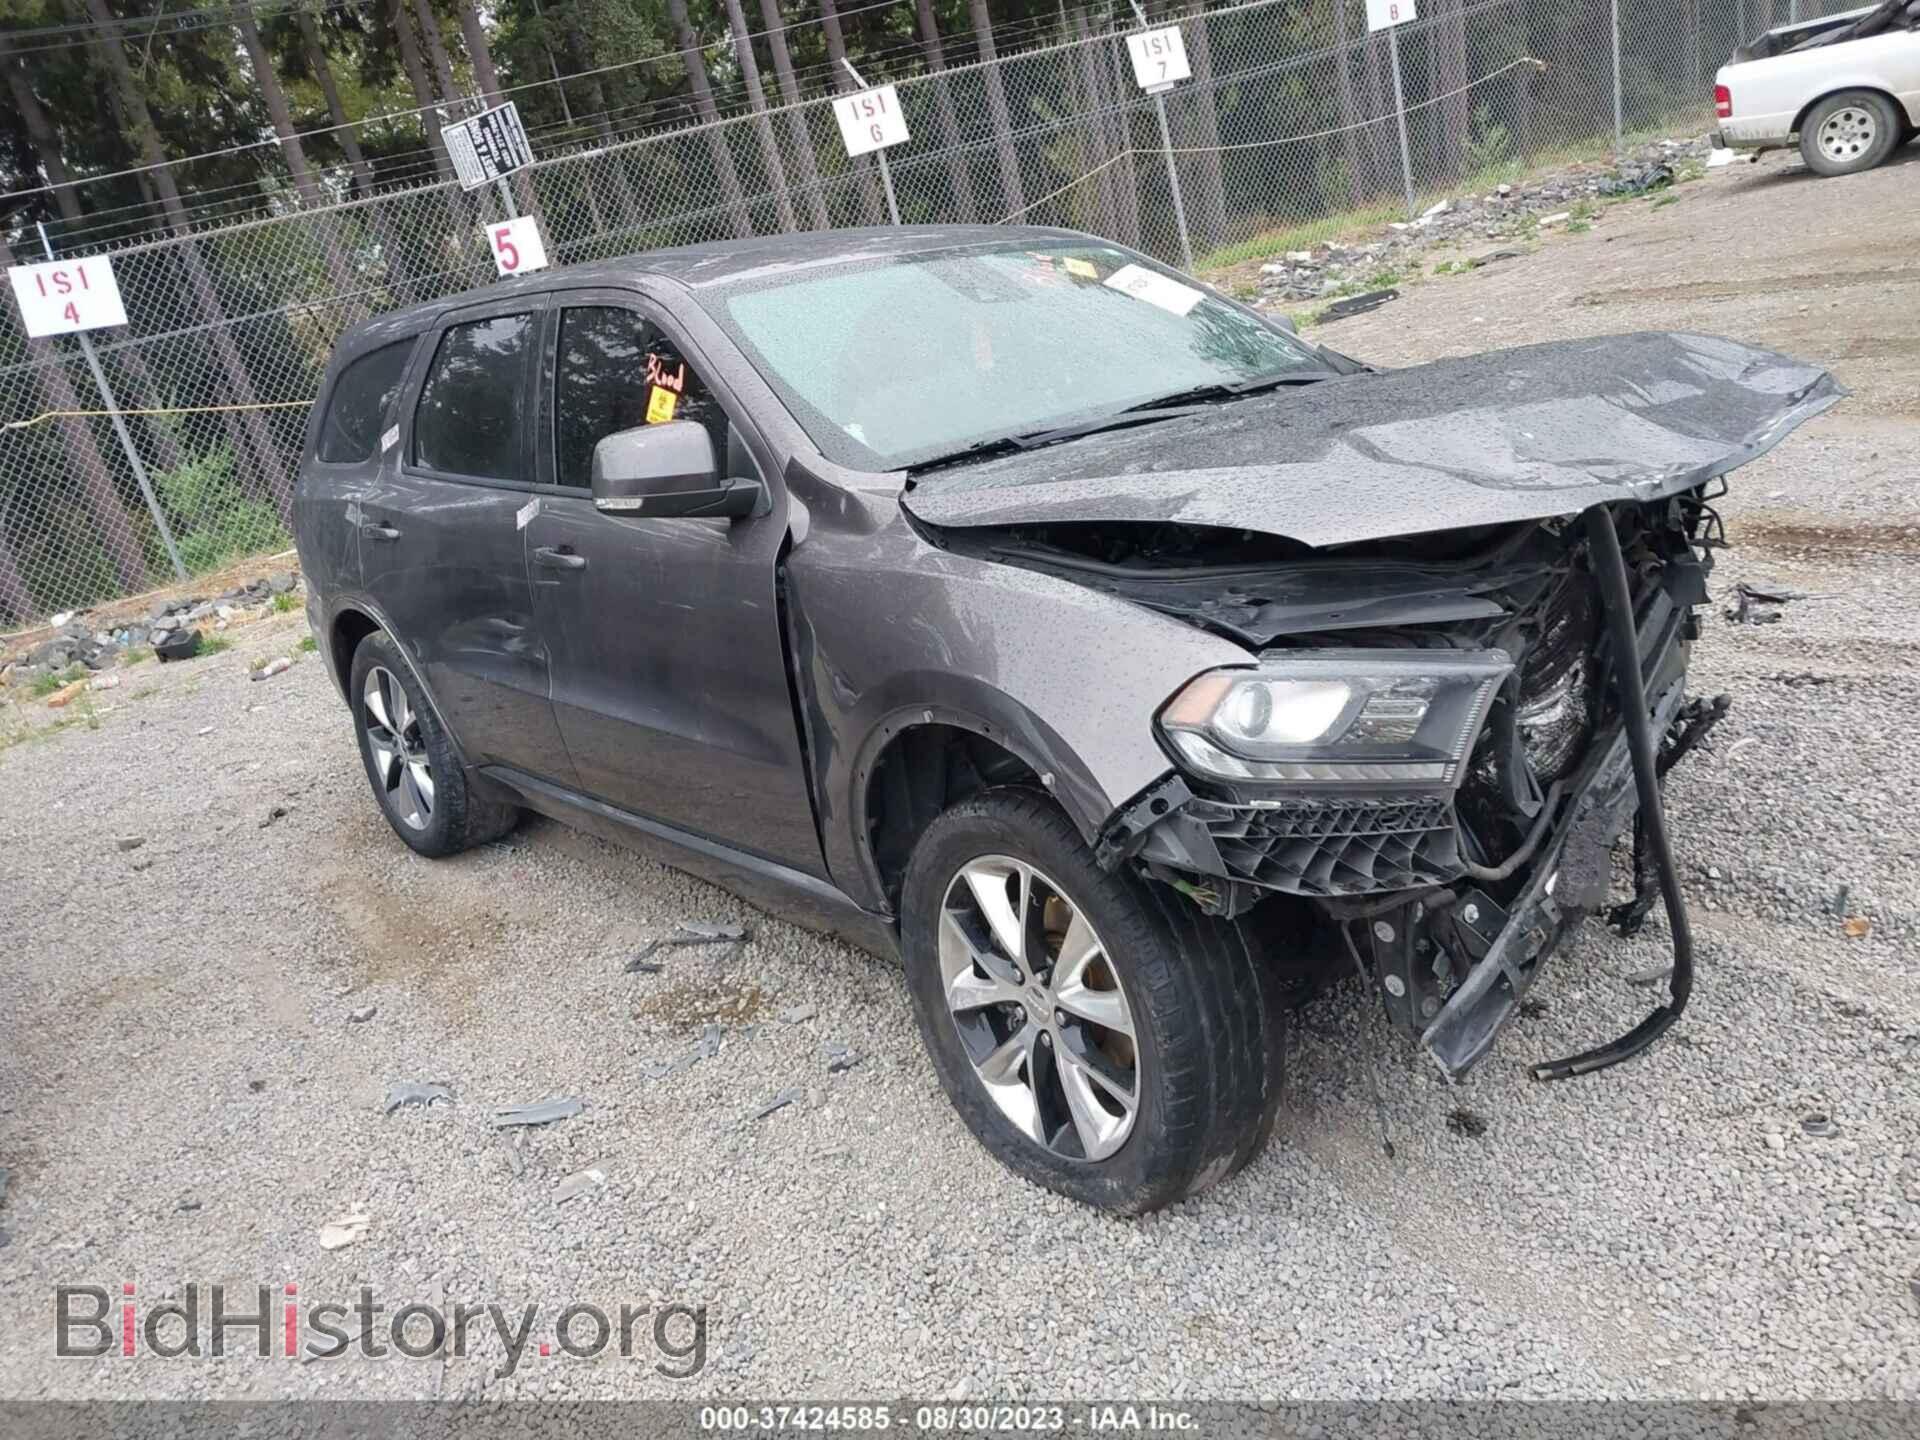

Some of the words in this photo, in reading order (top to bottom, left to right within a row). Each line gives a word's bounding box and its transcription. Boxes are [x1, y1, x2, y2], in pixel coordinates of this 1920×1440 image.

[1157, 61, 1167, 79] 7
[482, 126, 502, 162] TOWING
[495, 228, 519, 271] 5
[64, 301, 80, 325] 4
[646, 353, 685, 392] Blood
